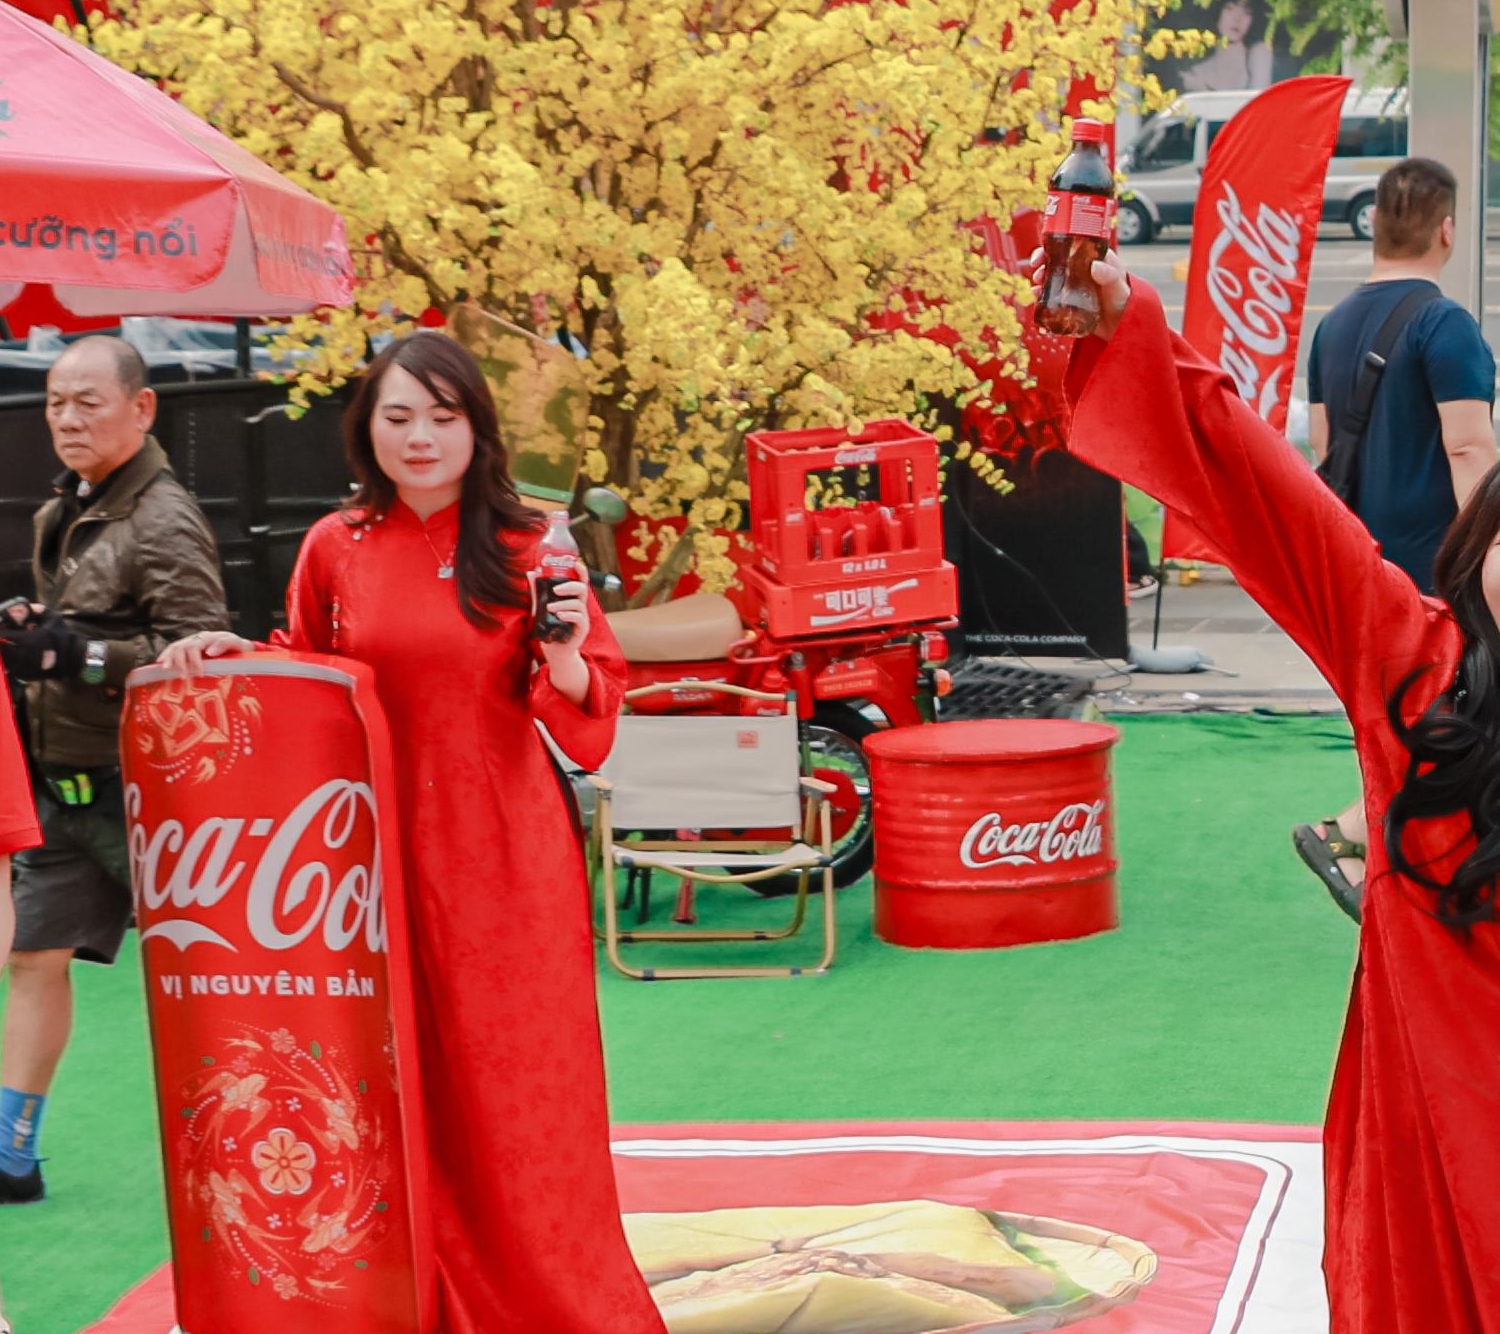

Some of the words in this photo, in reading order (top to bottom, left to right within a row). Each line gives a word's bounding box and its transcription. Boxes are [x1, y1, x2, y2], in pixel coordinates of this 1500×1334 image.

[133, 216, 198, 258] nổi
[1205, 179, 1302, 401] a-Cola
[965, 634, 983, 643] THE
[984, 634, 1040, 644] COCA-COLA
[1040, 634, 1088, 645] COMPANY
[959, 799, 1106, 869] Coca-Cola
[160, 974, 183, 1000] VỊ
[190, 970, 316, 997] NGUYÊN
[325, 969, 376, 998] BẢN
